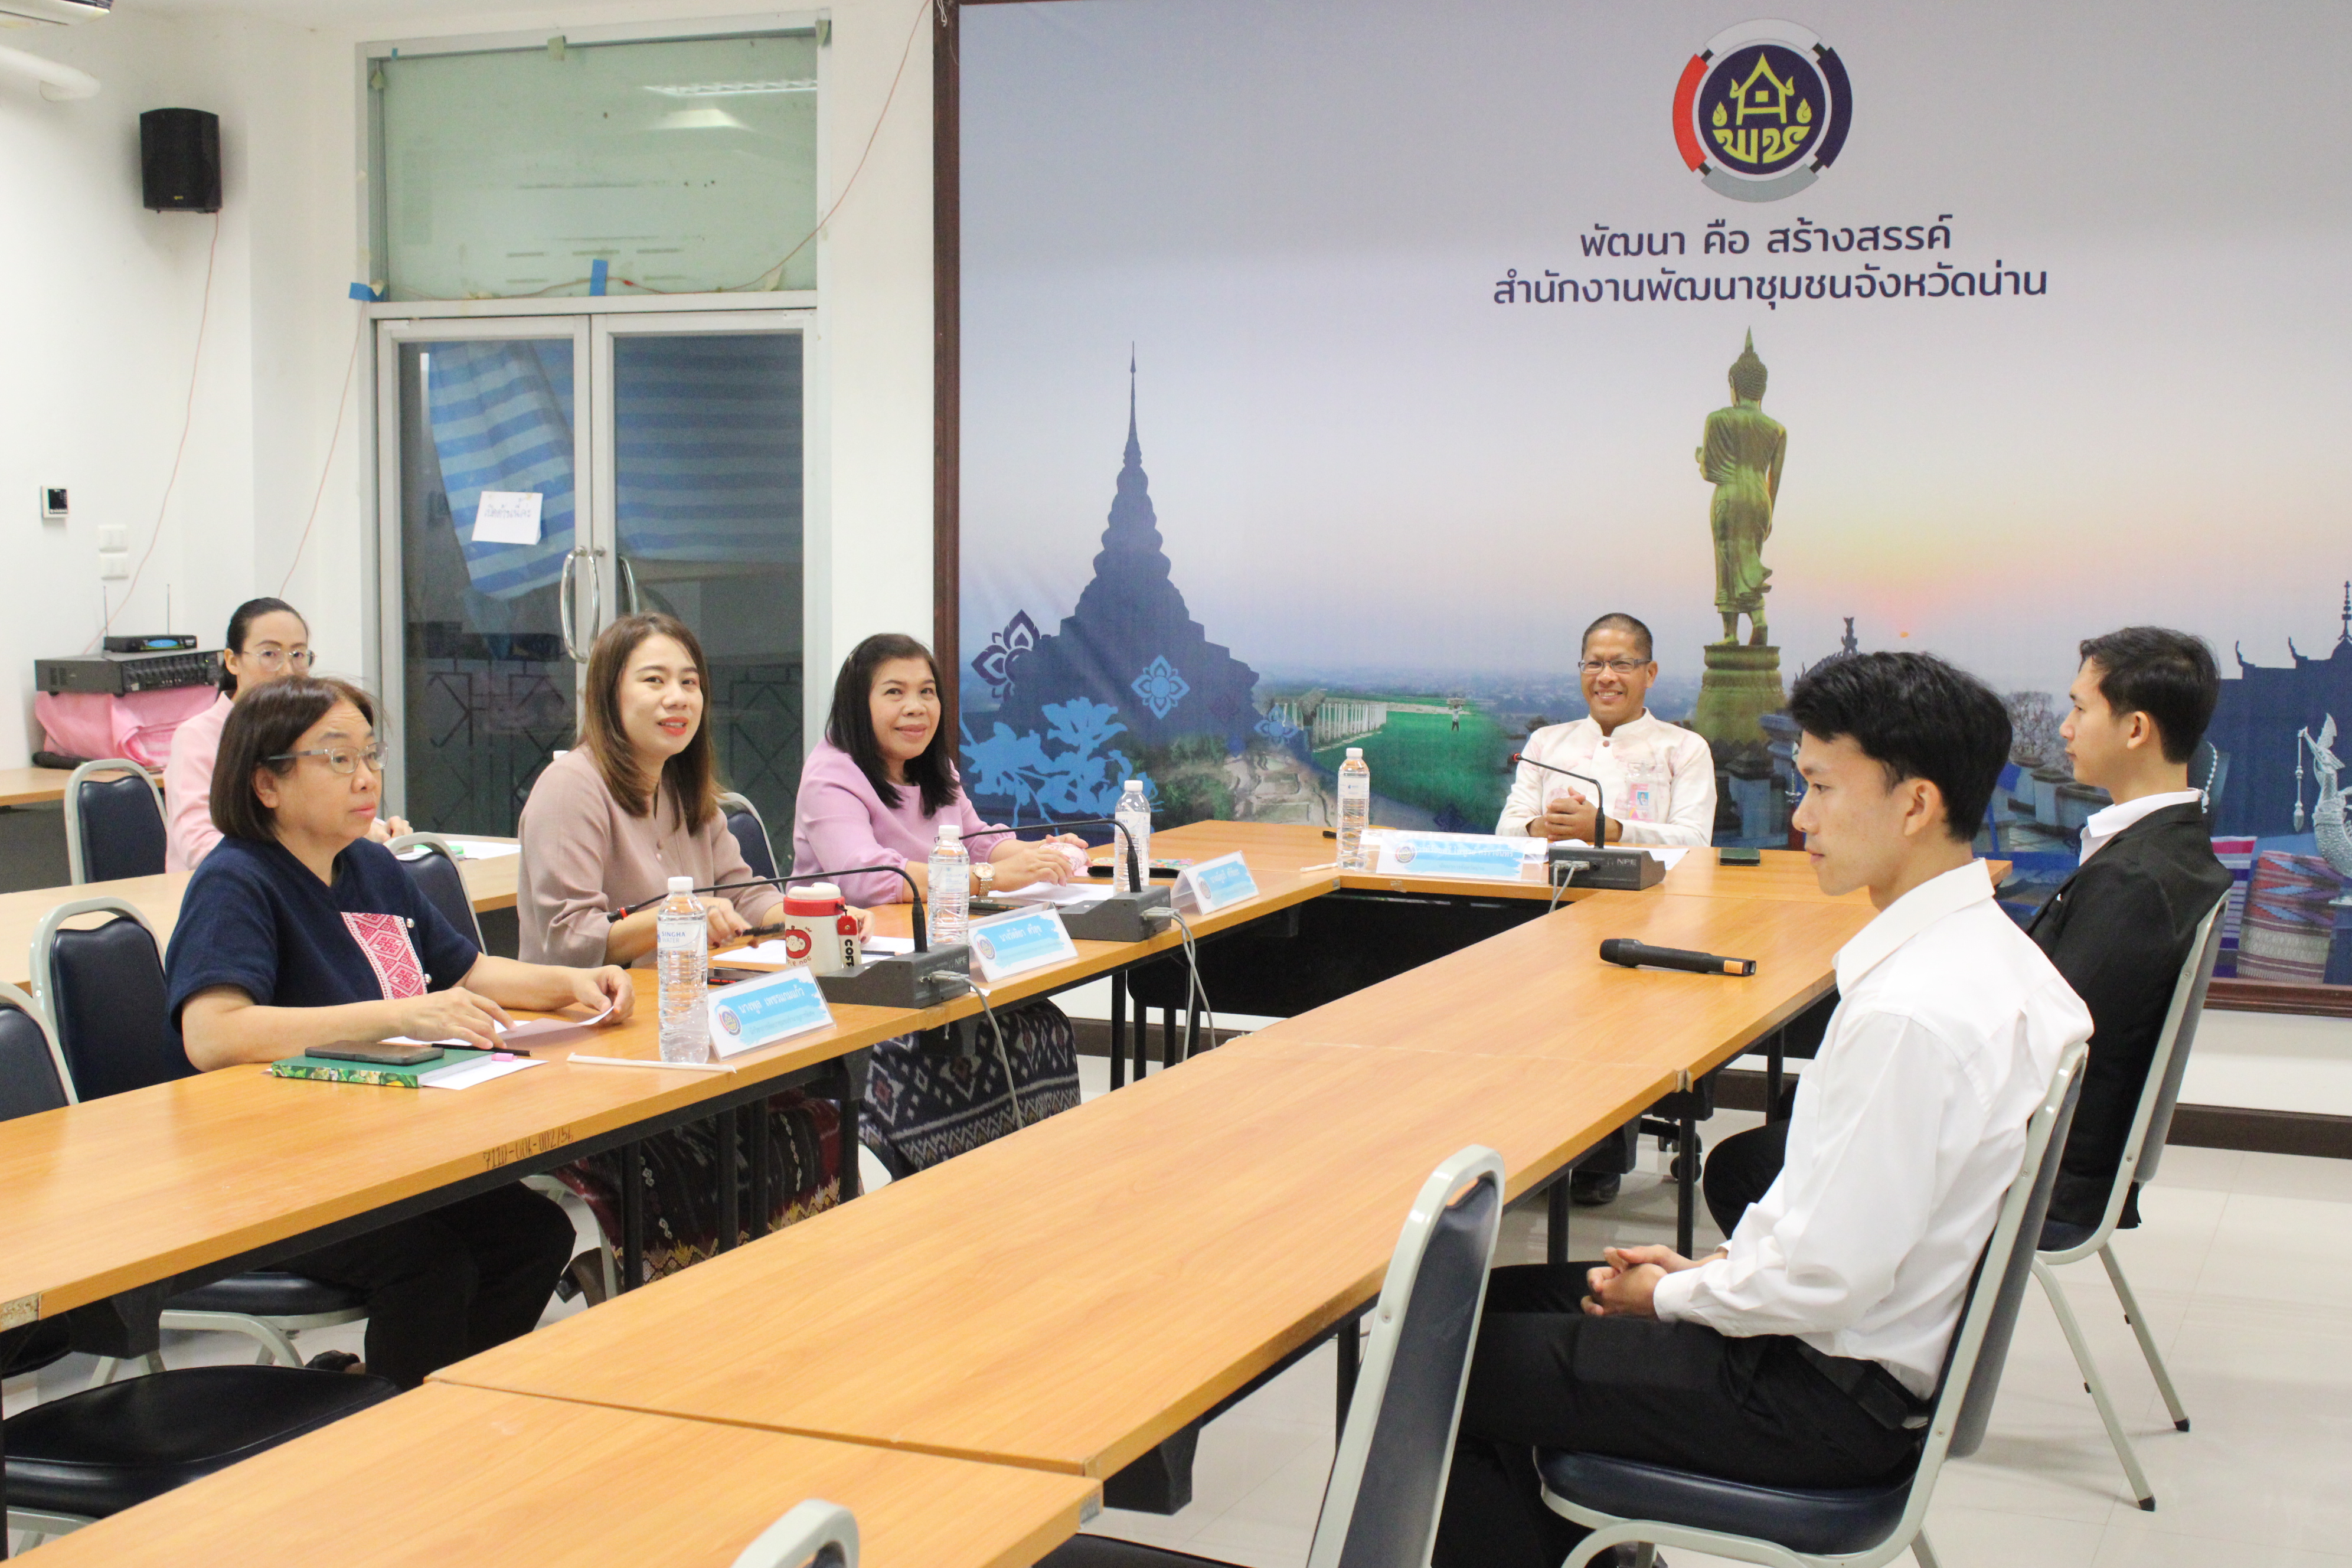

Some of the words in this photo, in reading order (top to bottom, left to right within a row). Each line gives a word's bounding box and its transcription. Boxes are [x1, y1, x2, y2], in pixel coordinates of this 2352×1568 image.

[1580, 223, 1685, 257] พัฒนา
[1704, 218, 1750, 255] คือ
[1766, 214, 1953, 254] สร้างสรรค์
[1493, 260, 2047, 311] สำนักงานพัฒนาชุมชนจังหวัดน่าน
[955, 956, 968, 965] NPE
